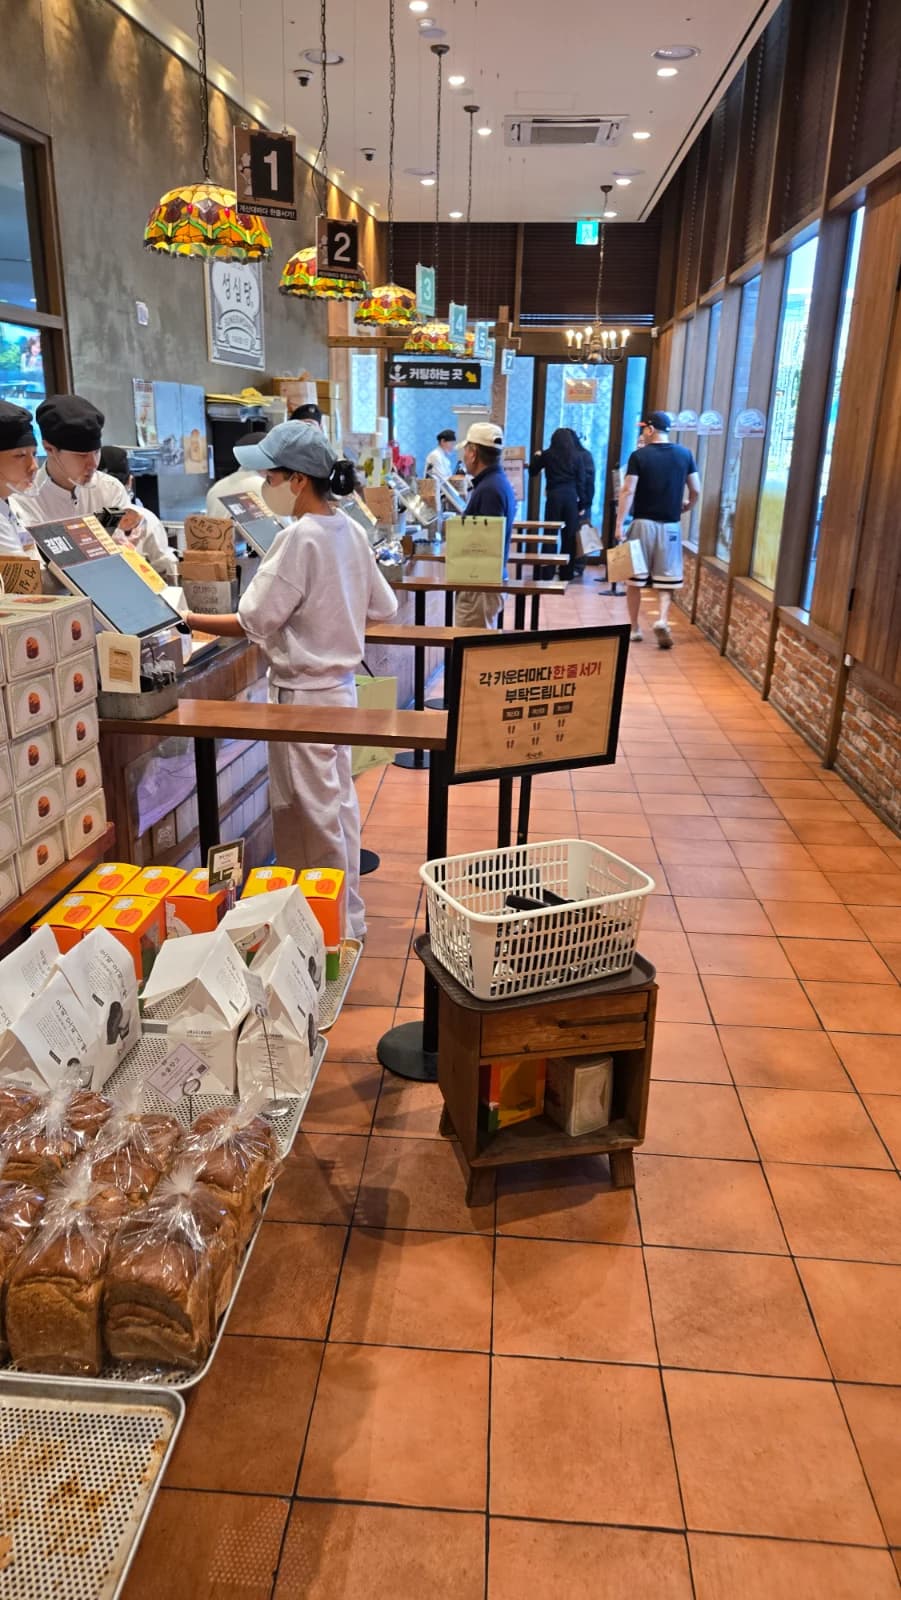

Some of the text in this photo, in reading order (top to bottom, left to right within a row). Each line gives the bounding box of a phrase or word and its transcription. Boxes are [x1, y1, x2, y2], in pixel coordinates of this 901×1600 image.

[263, 150, 278, 191] 1
[333, 231, 351, 262] 2
[222, 272, 253, 307] 성심당
[423, 278, 432, 301] 3
[455, 313, 463, 333] 4
[479, 331, 486, 348] 5
[506, 354, 513, 368] 7
[409, 368, 463, 381] 커팅하는 곳
[479, 661, 602, 687] 각 카운터마다 한 줄 서기
[505, 683, 576, 704] 부탁드립니다
